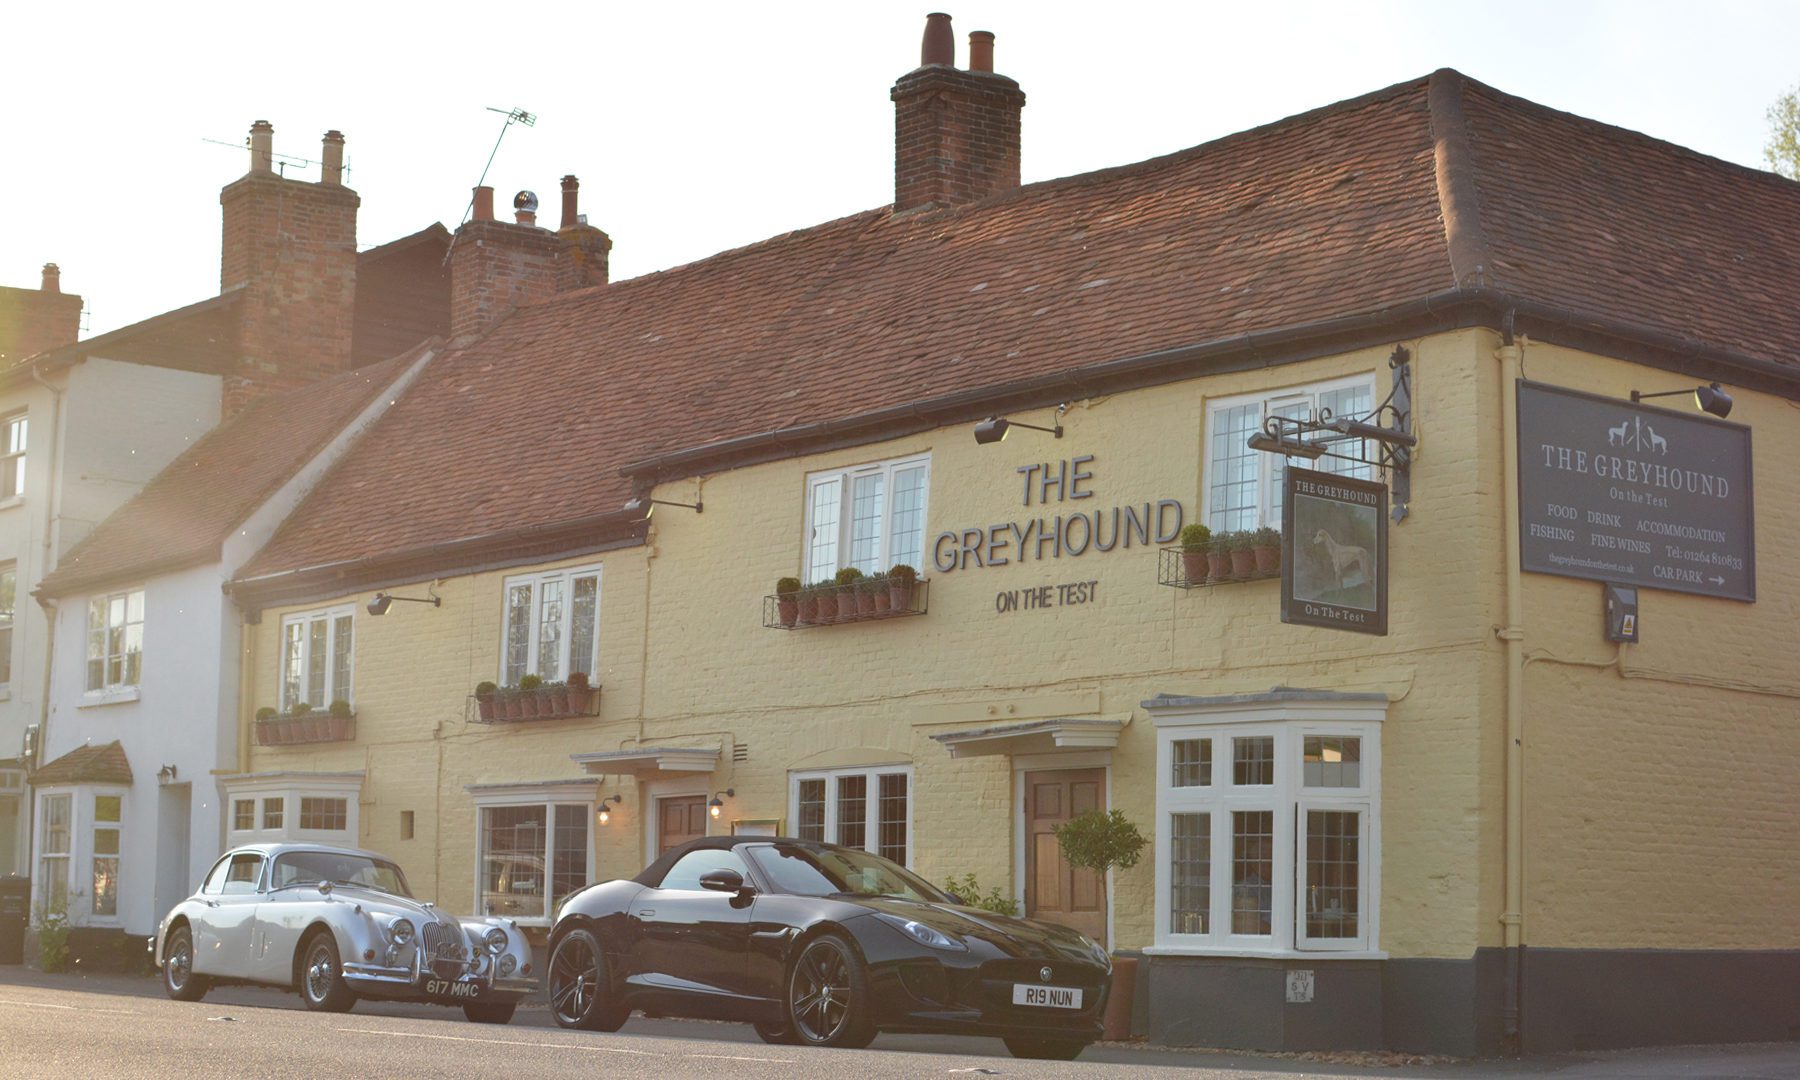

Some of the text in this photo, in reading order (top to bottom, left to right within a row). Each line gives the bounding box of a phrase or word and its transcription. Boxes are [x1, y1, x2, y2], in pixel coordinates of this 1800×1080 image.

[1017, 454, 1094, 506] THE
[1541, 444, 1729, 498] THE GREYHOUND
[1295, 480, 1377, 505] THE GREYHOUND
[1610, 487, 1669, 509] On the Test
[932, 499, 1183, 572] GREYHOUND
[1547, 503, 1726, 543] FOOD DRINK ACCOMMODATION
[1530, 523, 1743, 570] FISHING FINE WINES Tel: 01264 810833
[1653, 564, 1703, 584] CAR PARK
[995, 580, 1099, 613] ON THE TEST
[1305, 603, 1365, 623] On The Test
[426, 980, 479, 997] 617 MMC
[1026, 988, 1073, 1006] R19 NUN
